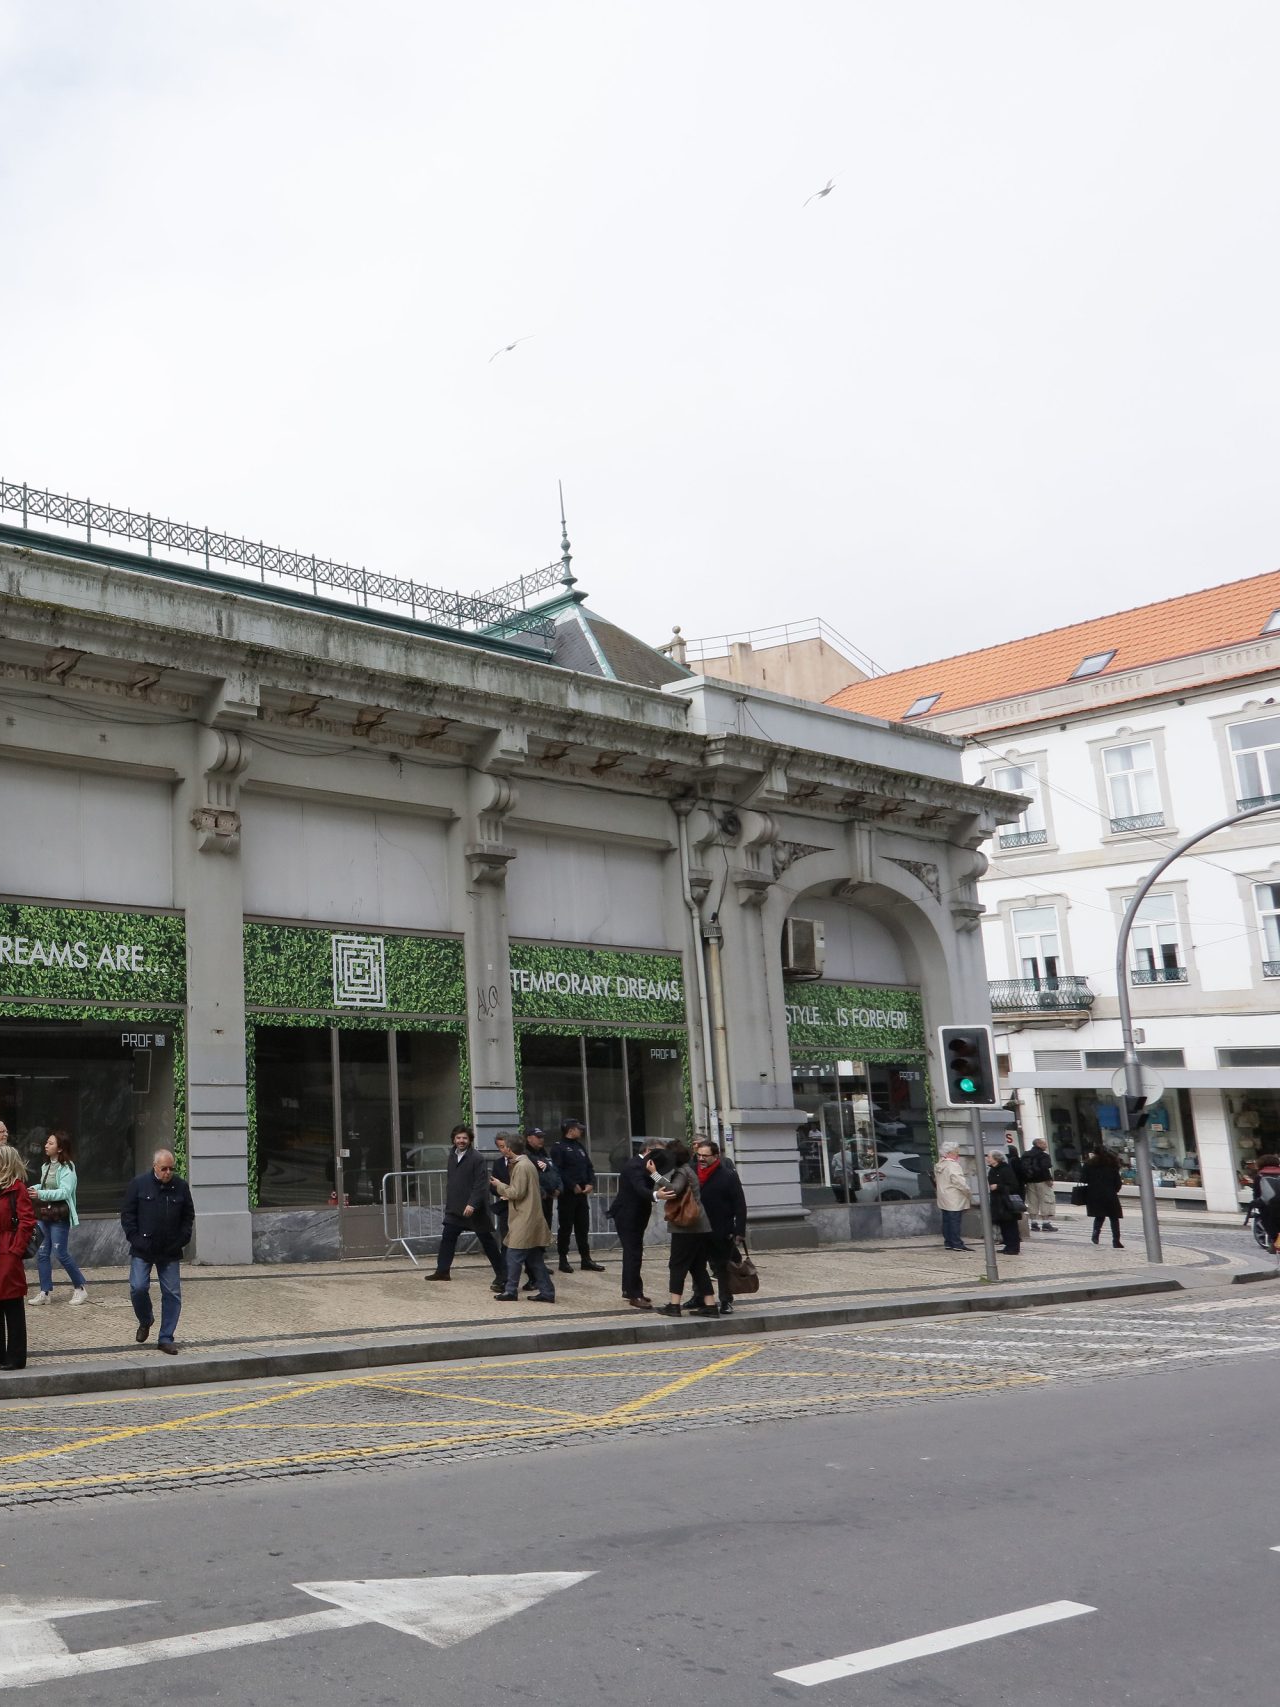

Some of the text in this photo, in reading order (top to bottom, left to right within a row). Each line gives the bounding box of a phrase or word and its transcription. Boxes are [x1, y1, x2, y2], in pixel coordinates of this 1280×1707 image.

[509, 969, 610, 997] TEMPORARY
[837, 1008, 849, 1027] IS
[852, 1009, 908, 1029] FOREVER!
[121, 1033, 153, 1047] PROF
